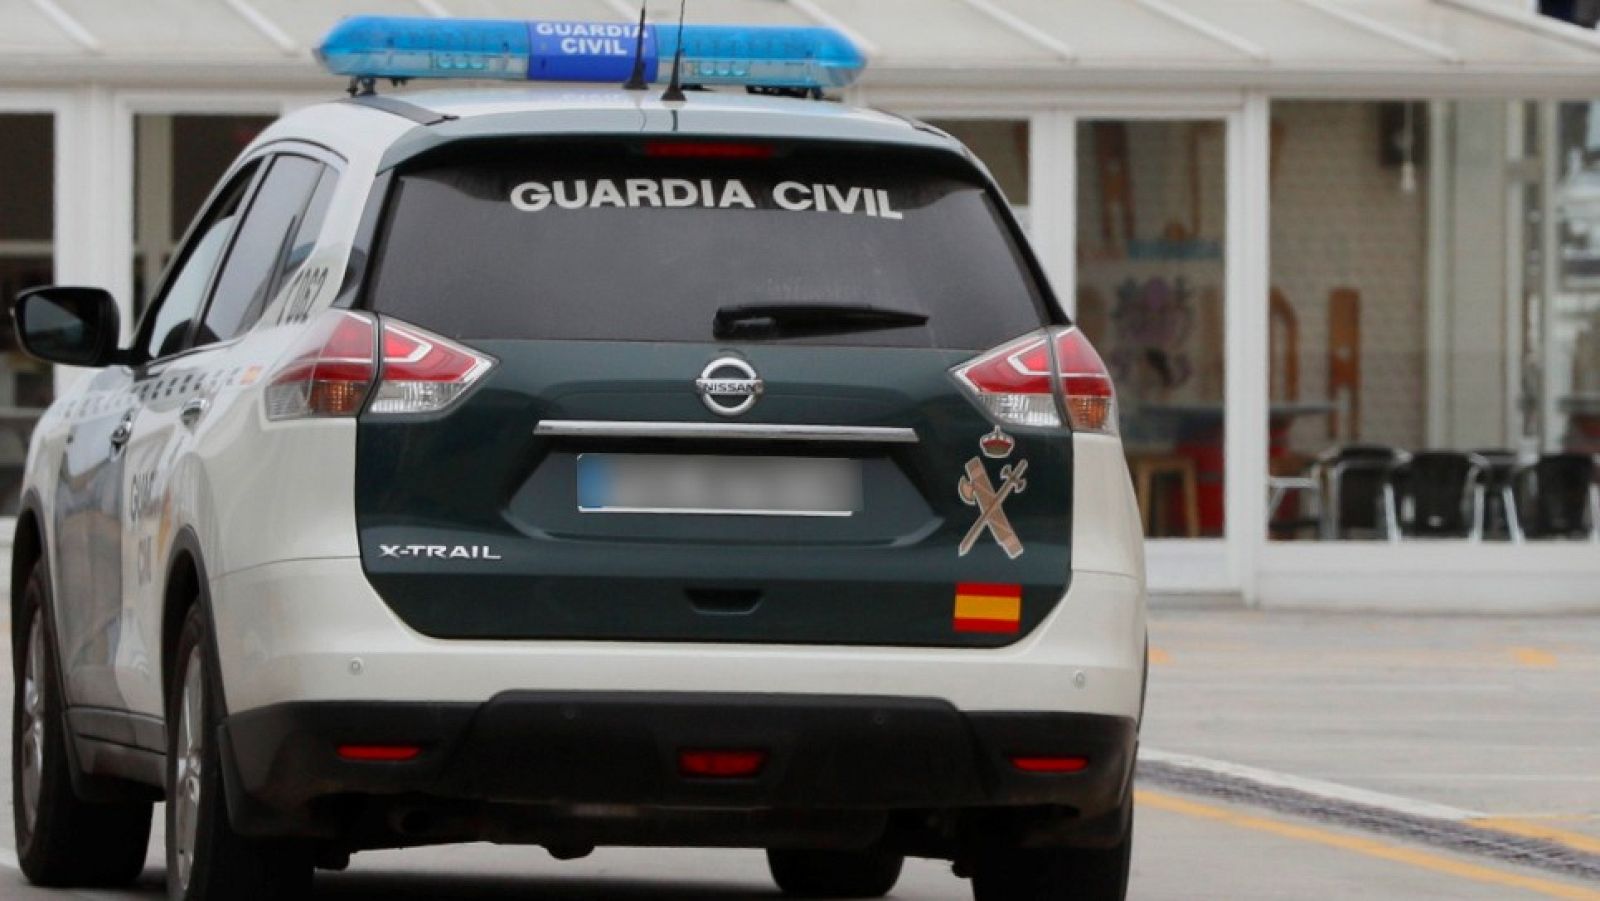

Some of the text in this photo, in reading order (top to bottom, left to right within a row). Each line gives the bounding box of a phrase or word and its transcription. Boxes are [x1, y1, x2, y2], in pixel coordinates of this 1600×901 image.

[536, 22, 648, 38] GUARDIA
[561, 38, 627, 55] CIVIL
[510, 178, 903, 220] GUARDIA CIVIL
[704, 382, 754, 394] NISSAN
[379, 543, 502, 560] X-TRAIL
